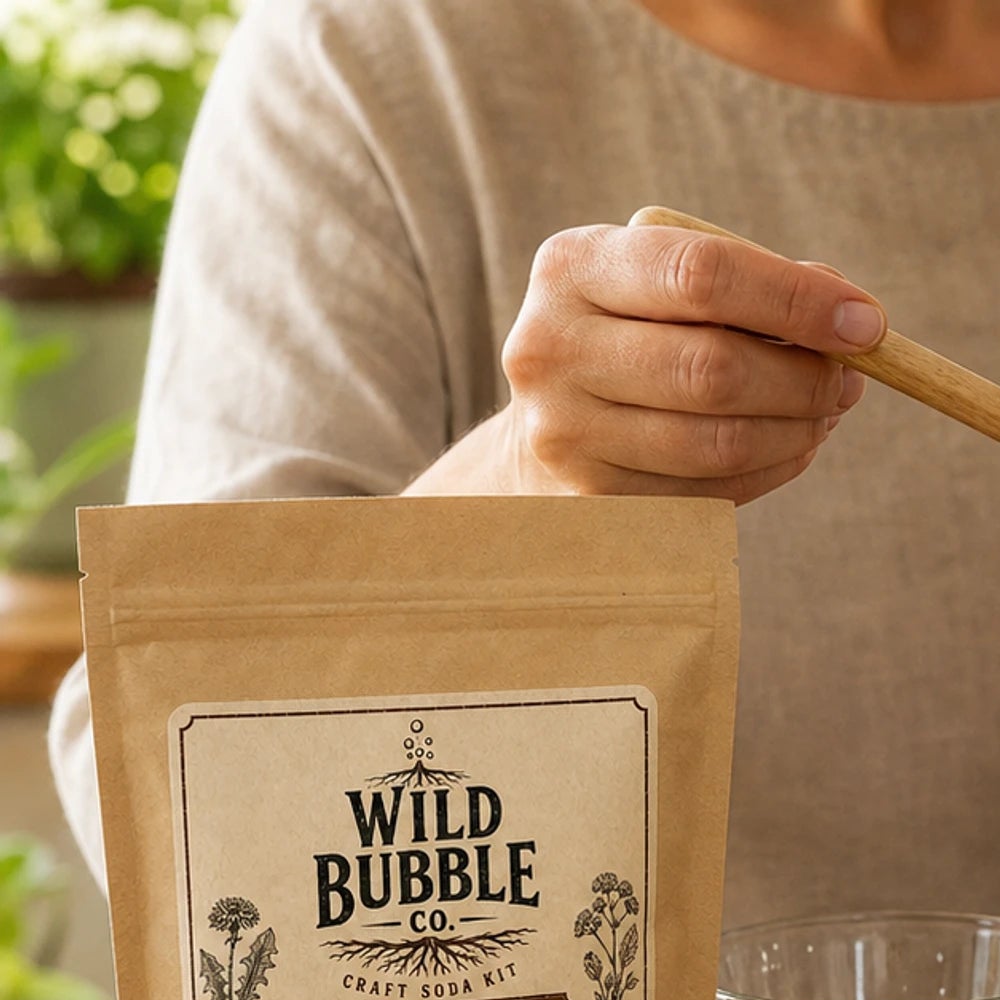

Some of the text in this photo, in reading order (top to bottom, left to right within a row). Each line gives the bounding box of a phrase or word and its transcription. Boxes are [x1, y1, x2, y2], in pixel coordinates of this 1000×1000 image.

[345, 785, 502, 848] WILD
[313, 841, 540, 929] BUBBLE
[409, 910, 455, 932] CO.
[342, 963, 518, 998] CRAFT SODA KIT
